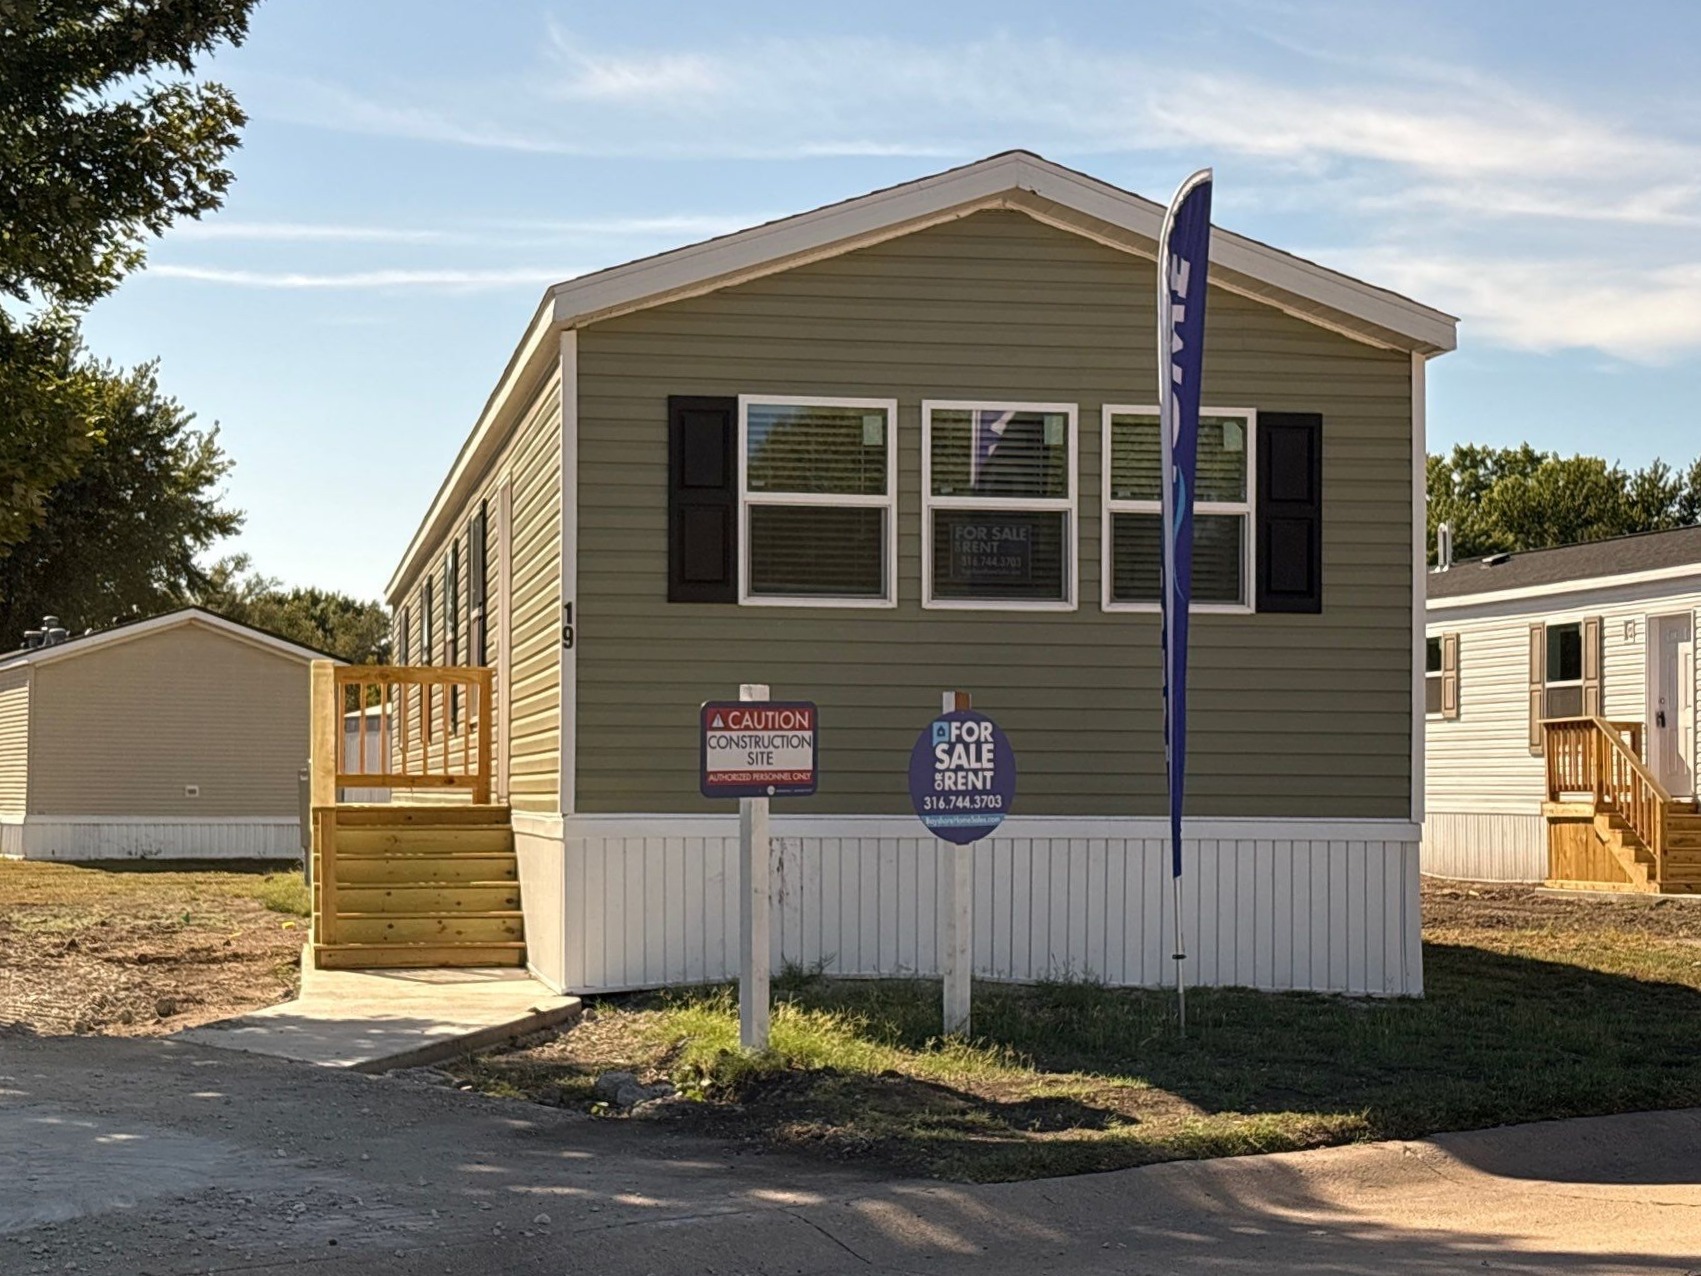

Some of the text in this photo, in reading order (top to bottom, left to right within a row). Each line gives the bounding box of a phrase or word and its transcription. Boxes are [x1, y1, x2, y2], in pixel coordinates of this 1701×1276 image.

[955, 526, 1027, 541] FOR SALE
[962, 541, 1000, 553] RENT
[562, 601, 574, 650] 19
[728, 711, 809, 729] CAUTION
[950, 721, 994, 742] FOR
[708, 734, 812, 749] CONSTRUCTION
[747, 751, 774, 765] SITE
[935, 743, 994, 770] SALE
[708, 772, 812, 781] AUTHORIZED PERSONNEL ONLY
[934, 771, 994, 791] OR RENT
[923, 795, 1002, 810] 316.744.3703
